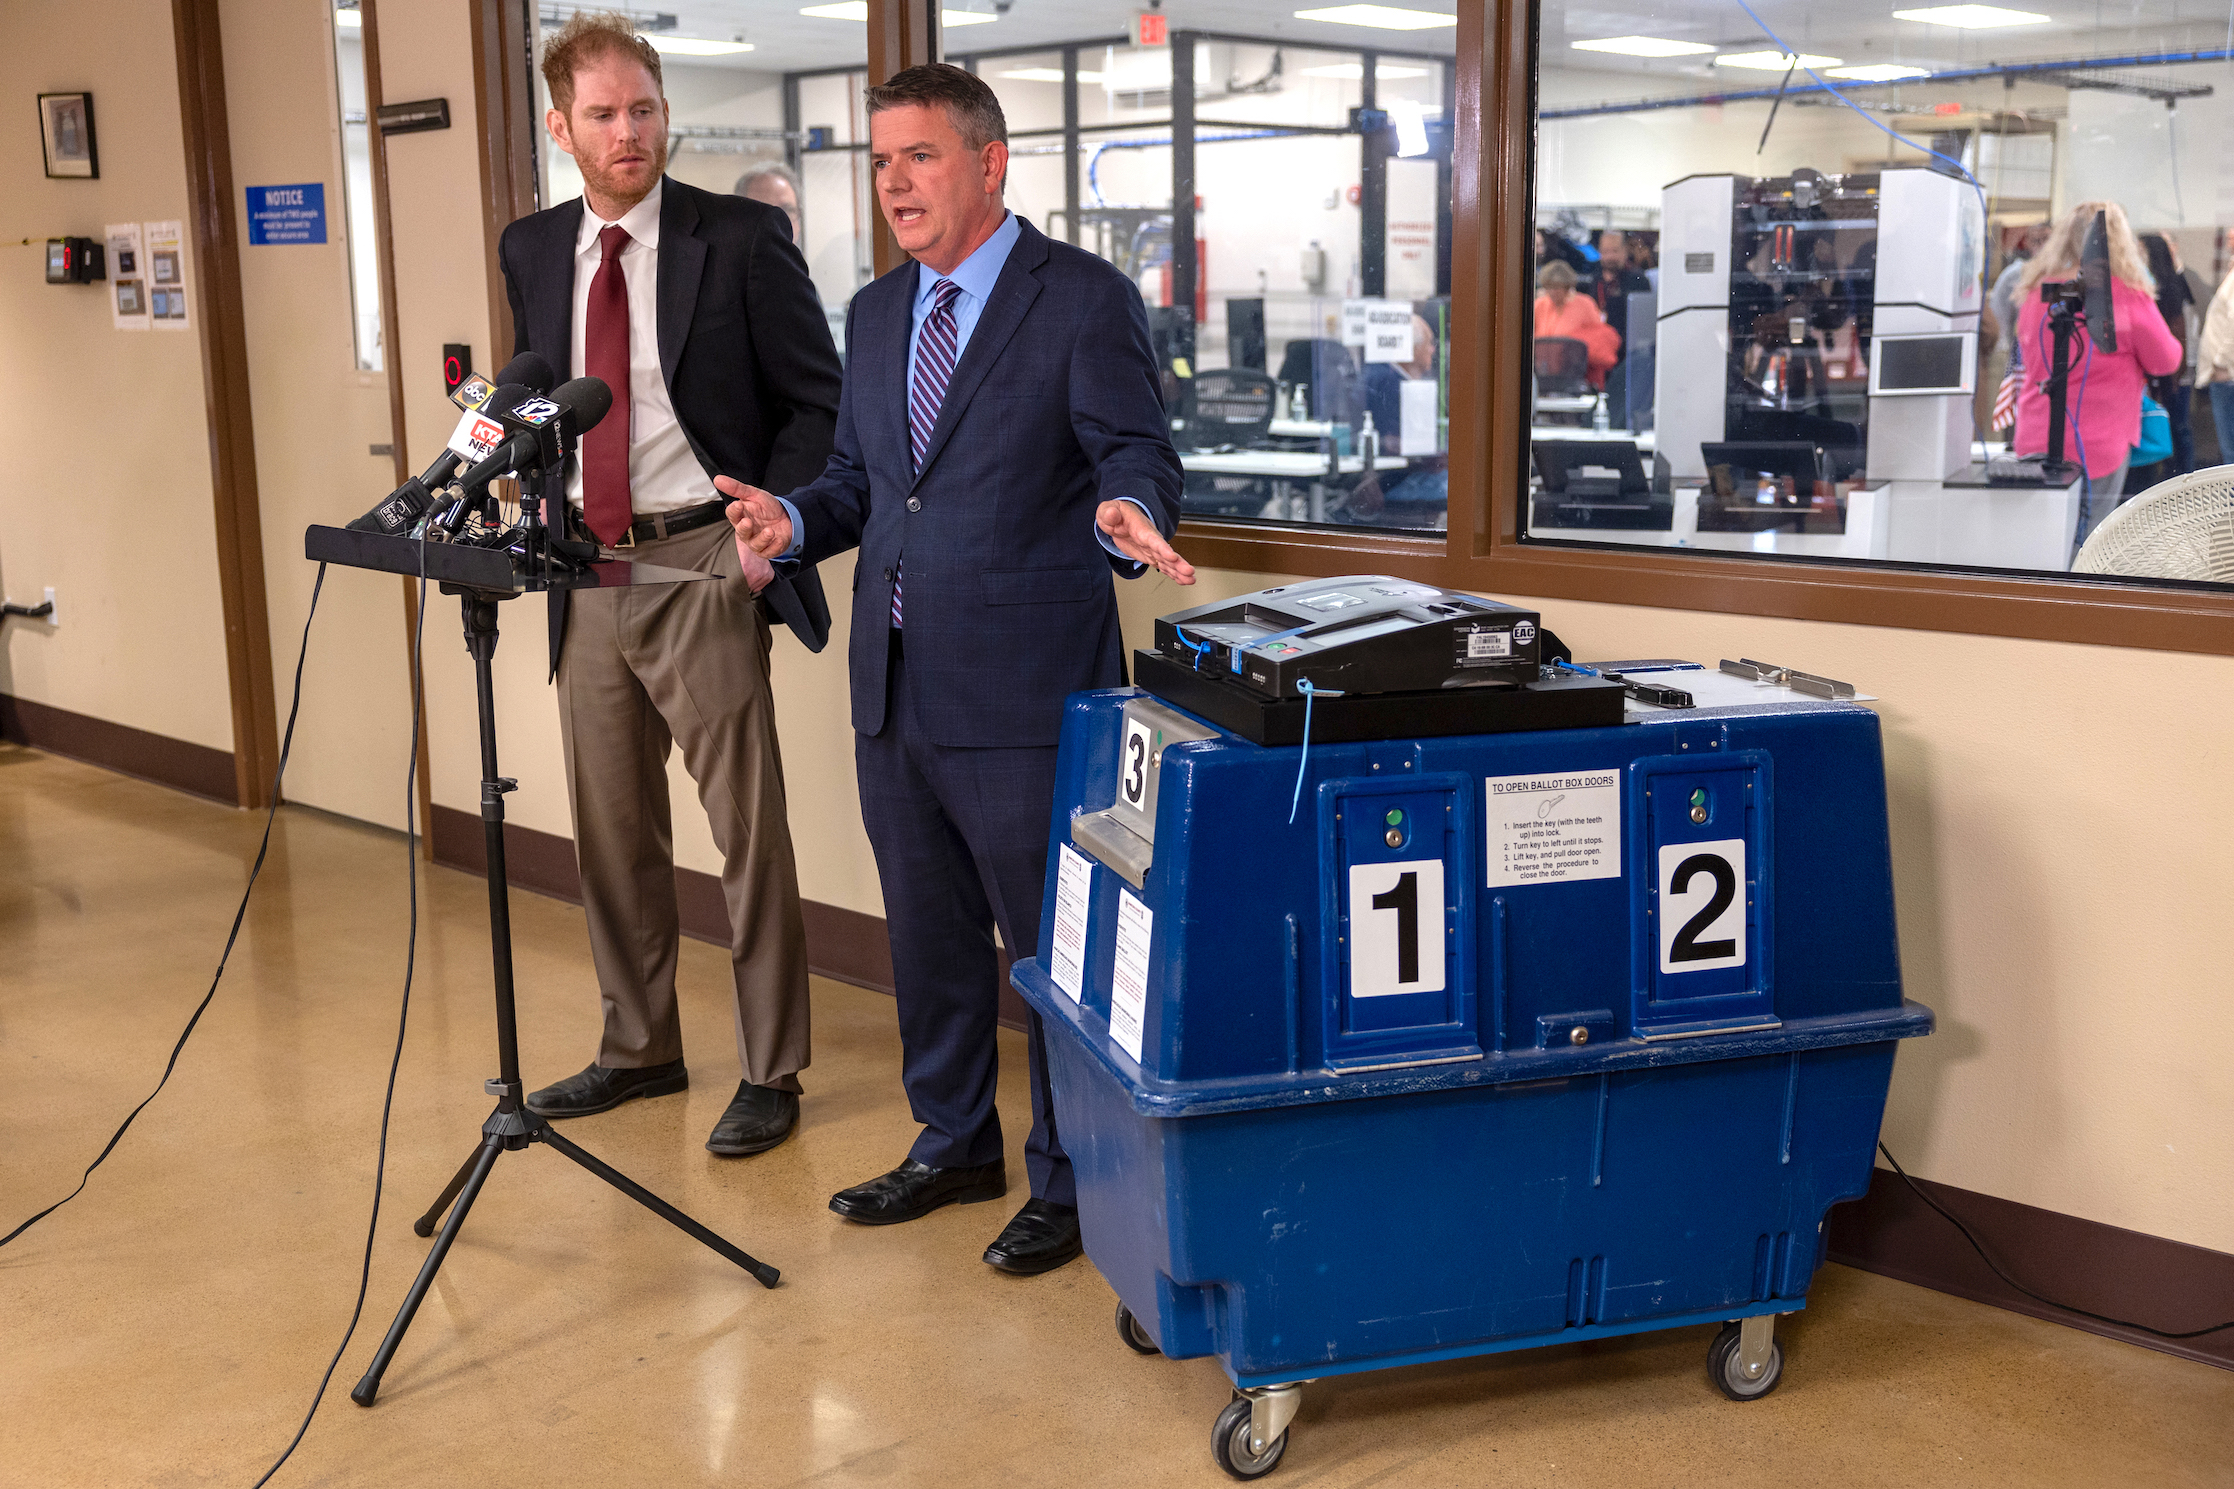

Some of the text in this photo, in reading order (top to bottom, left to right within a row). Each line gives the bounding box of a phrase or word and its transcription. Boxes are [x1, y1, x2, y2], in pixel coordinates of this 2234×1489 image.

[265, 189, 304, 206] NOTICE
[464, 385, 486, 402] abc
[519, 402, 559, 418] 12
[475, 423, 503, 443] KTA
[1514, 628, 1534, 638] EAC
[1125, 733, 1145, 803] 3
[1492, 776, 1614, 792] TO OPEN BALLOT BOX DOORS
[1513, 821, 1531, 829] Insert
[1532, 820, 1543, 828] the
[1544, 819, 1556, 829] key
[1557, 818, 1573, 828] (with
[1574, 817, 1585, 825] the
[1586, 816, 1602, 824] teeth
[1519, 829, 1561, 839] up) into lock.
[1504, 837, 1603, 851] 2. Turn key to left until it stops.
[1504, 848, 1602, 862] 3. Lift key, and pull door open.
[1504, 858, 1599, 873] 4. Reverse the procedure to
[1520, 869, 1568, 879] close the door.
[1669, 853, 1736, 964] 2
[1372, 871, 1419, 984] 1
